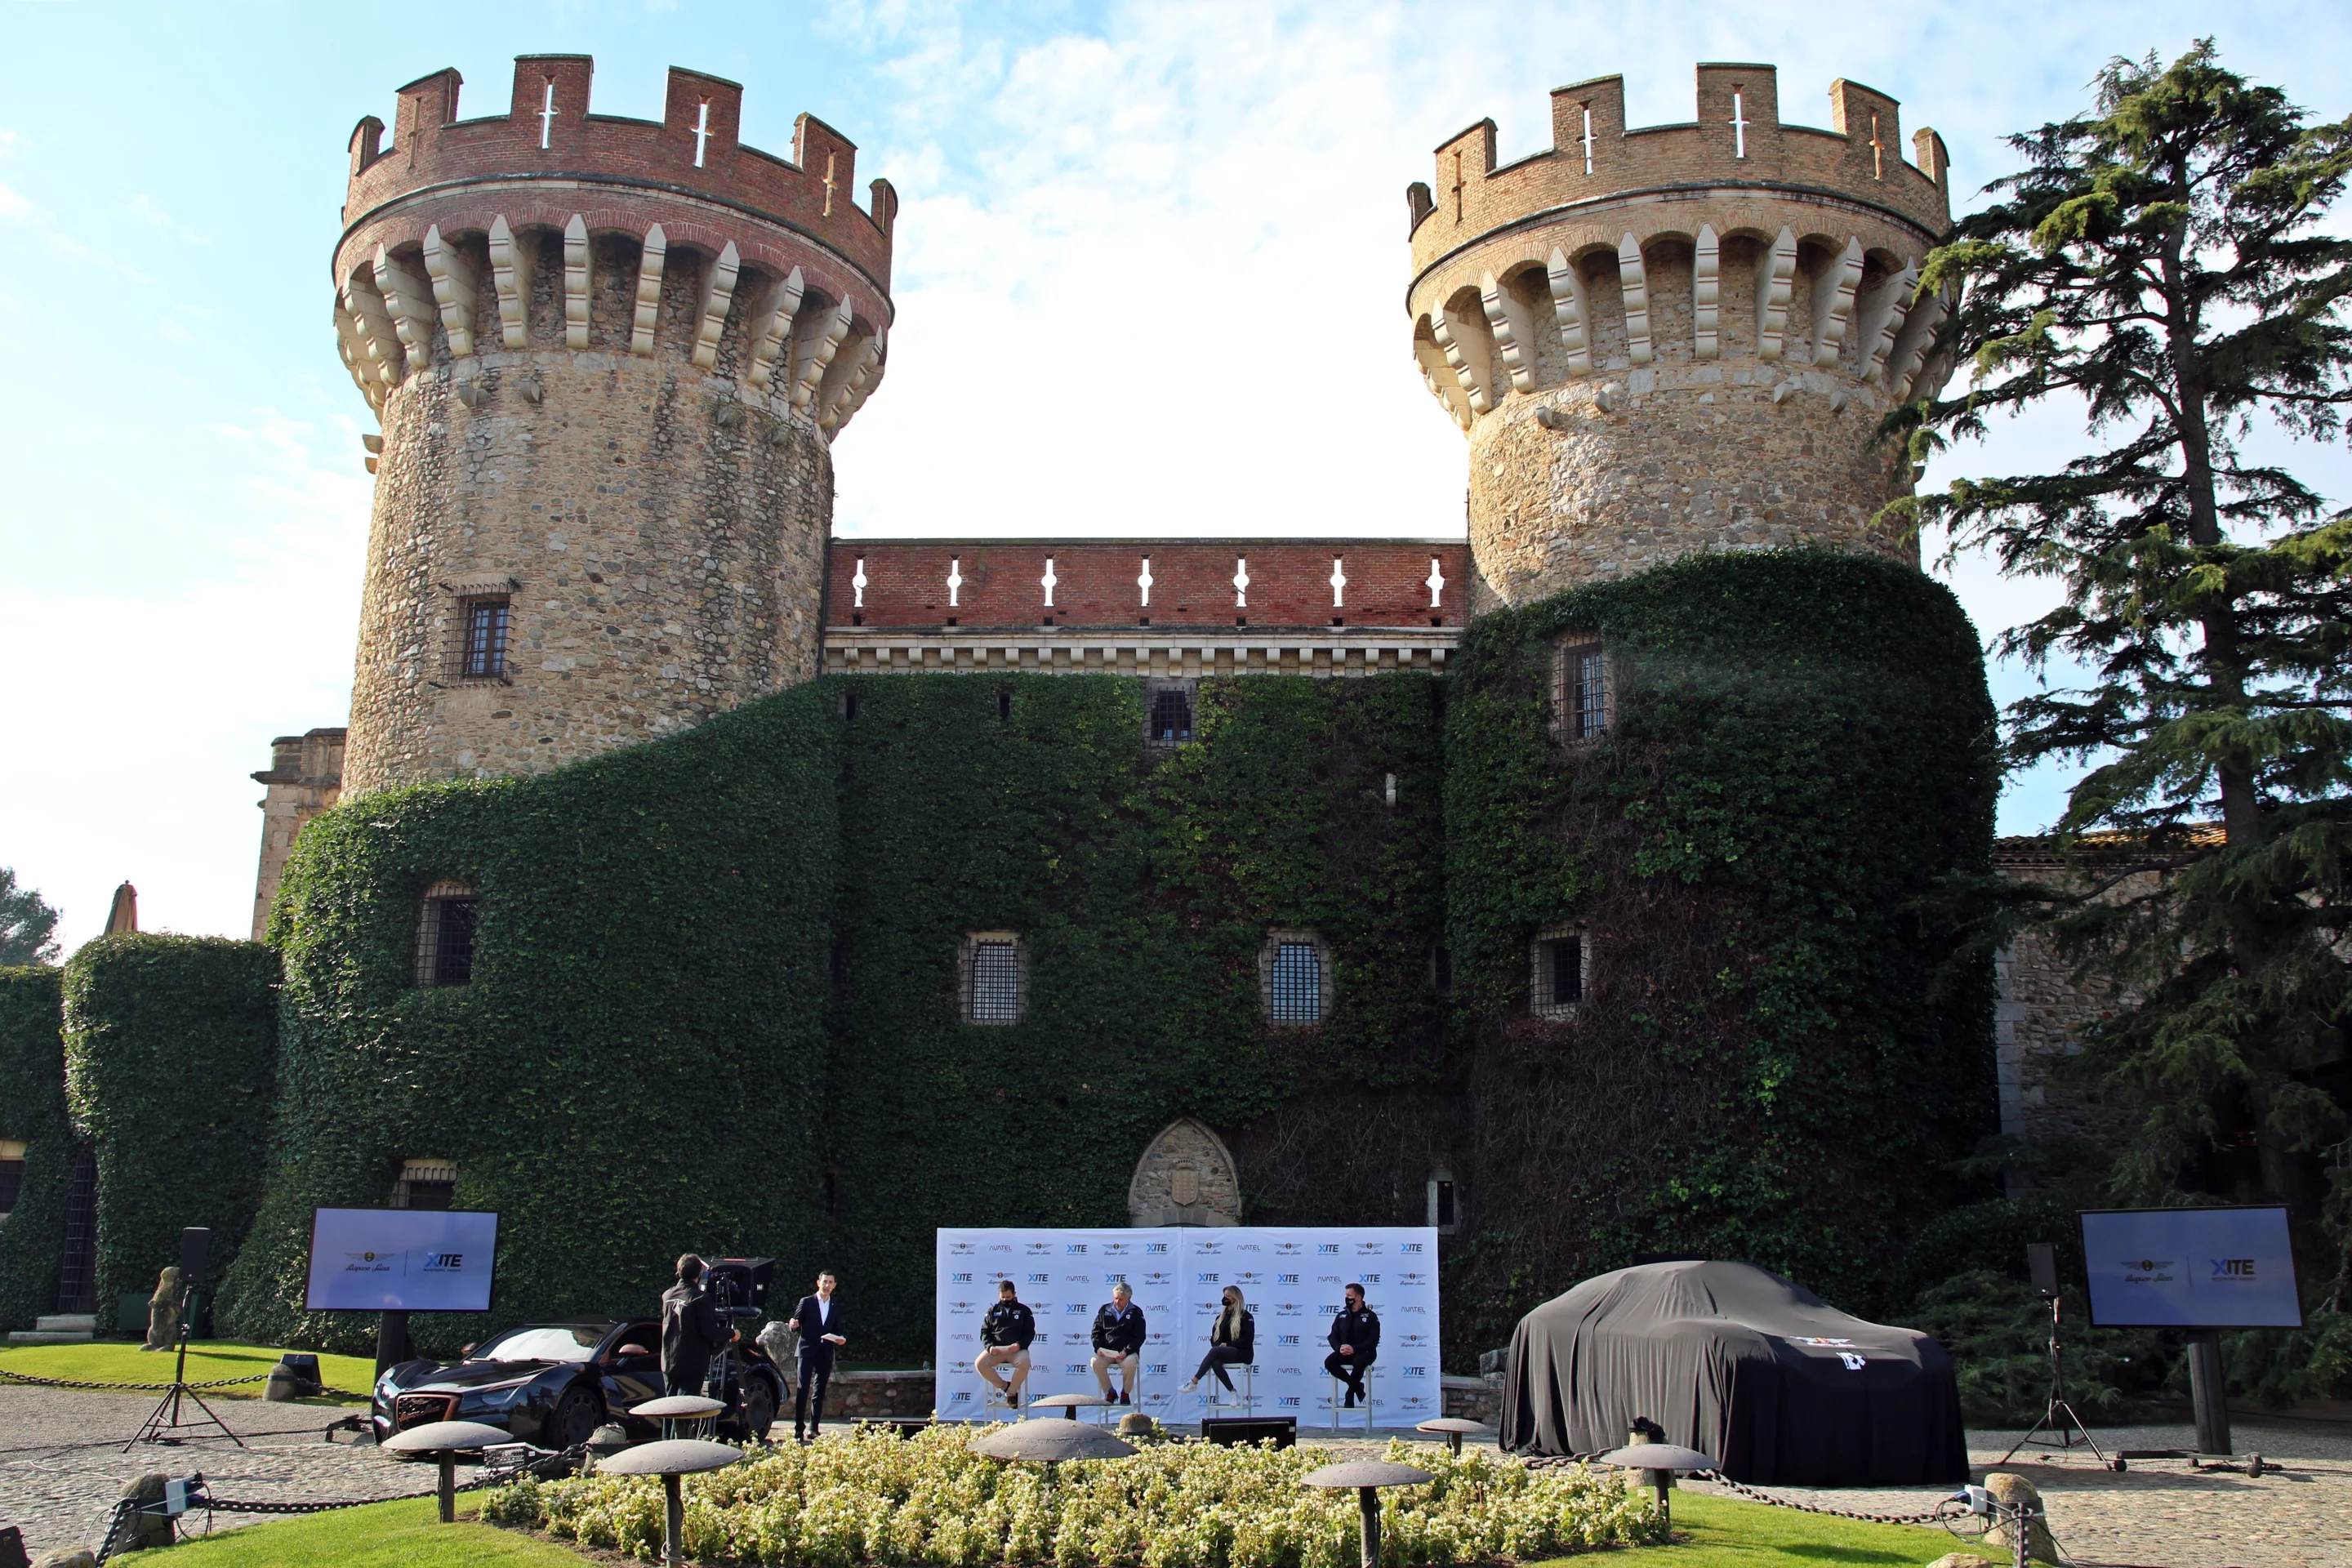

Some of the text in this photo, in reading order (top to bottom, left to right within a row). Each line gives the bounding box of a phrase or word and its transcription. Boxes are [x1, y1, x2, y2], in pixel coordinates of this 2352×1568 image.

[1067, 1245, 1087, 1253] XITE
[1147, 1244, 1167, 1252] XITE
[1401, 1244, 1423, 1252] XITE
[425, 1253, 463, 1267] XITE
[2209, 1258, 2255, 1276] XITE
[952, 1273, 973, 1281] XITE
[1106, 1274, 1126, 1282] XITE
[1198, 1273, 1219, 1281] XITE
[1278, 1274, 1299, 1282] XITE
[1359, 1274, 1380, 1282] XITE
[1067, 1304, 1087, 1312] XITE
[1318, 1305, 1339, 1313] XITE
[1031, 1334, 1048, 1342] ITE
[1278, 1335, 1299, 1343] XITE
[1067, 1364, 1086, 1372] XITE
[1147, 1364, 1167, 1373] XITE
[1403, 1367, 1425, 1375] XITE
[951, 1392, 971, 1401] XITE
[1279, 1397, 1300, 1405] XITE
